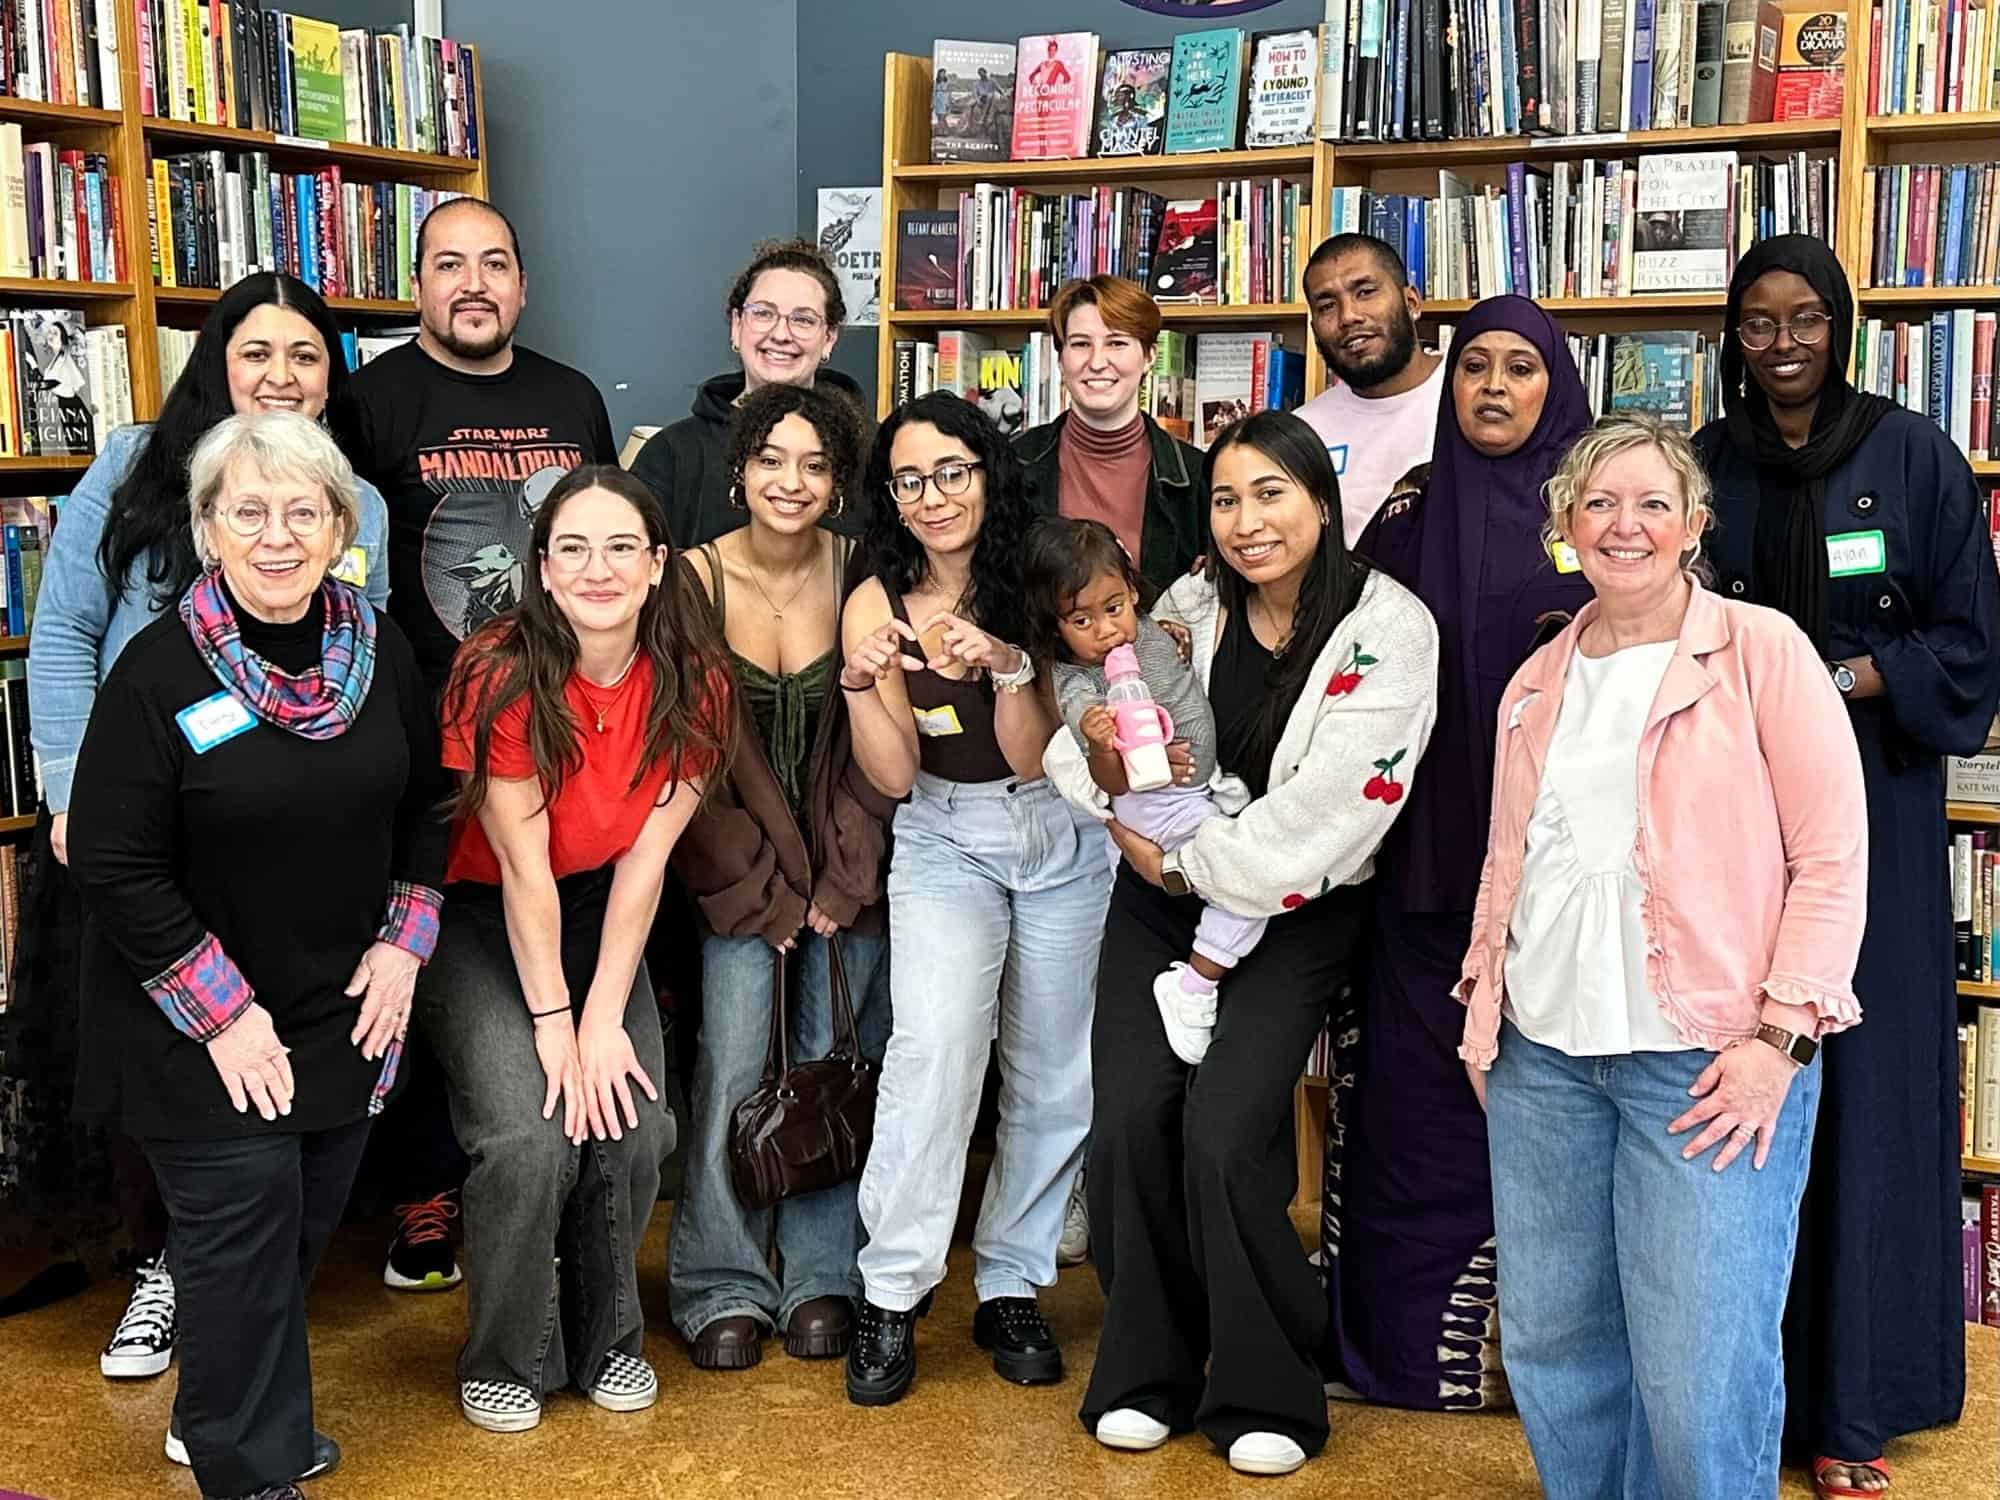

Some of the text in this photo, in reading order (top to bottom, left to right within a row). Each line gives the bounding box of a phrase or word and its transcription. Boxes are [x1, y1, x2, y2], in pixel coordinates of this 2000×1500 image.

[1802, 30, 1845, 41] WORLD
[1800, 39, 1845, 50] DRAMA
[1109, 52, 1171, 67] BURSTING
[1268, 48, 1307, 63] HOW TO
[1273, 64, 1299, 76] BE A
[1022, 84, 1074, 97] BECOMING
[1263, 77, 1309, 91] (YOUNG)
[1258, 89, 1313, 104] ANTIRACIST
[1099, 127, 1160, 142] CHANTEL
[1100, 139, 1156, 153] MASSEY
[1642, 158, 1729, 174] A PRAYER
[1641, 179, 1672, 191] FOR
[1641, 192, 1720, 209] THE CITY
[832, 251, 881, 269] OETR
[1638, 254, 1680, 269] BUZZ
[1637, 270, 1724, 287] BISSINGER
[1931, 329, 1945, 361] GOOD
[980, 356, 1023, 390] KIN
[1931, 361, 1944, 401] WORDS
[448, 427, 550, 441] STAR WARS
[493, 442, 512, 450] THE
[1956, 783, 1979, 793] KATE
[1991, 1194, 1999, 1226] TALES
[1991, 1227, 1999, 1241] OF
